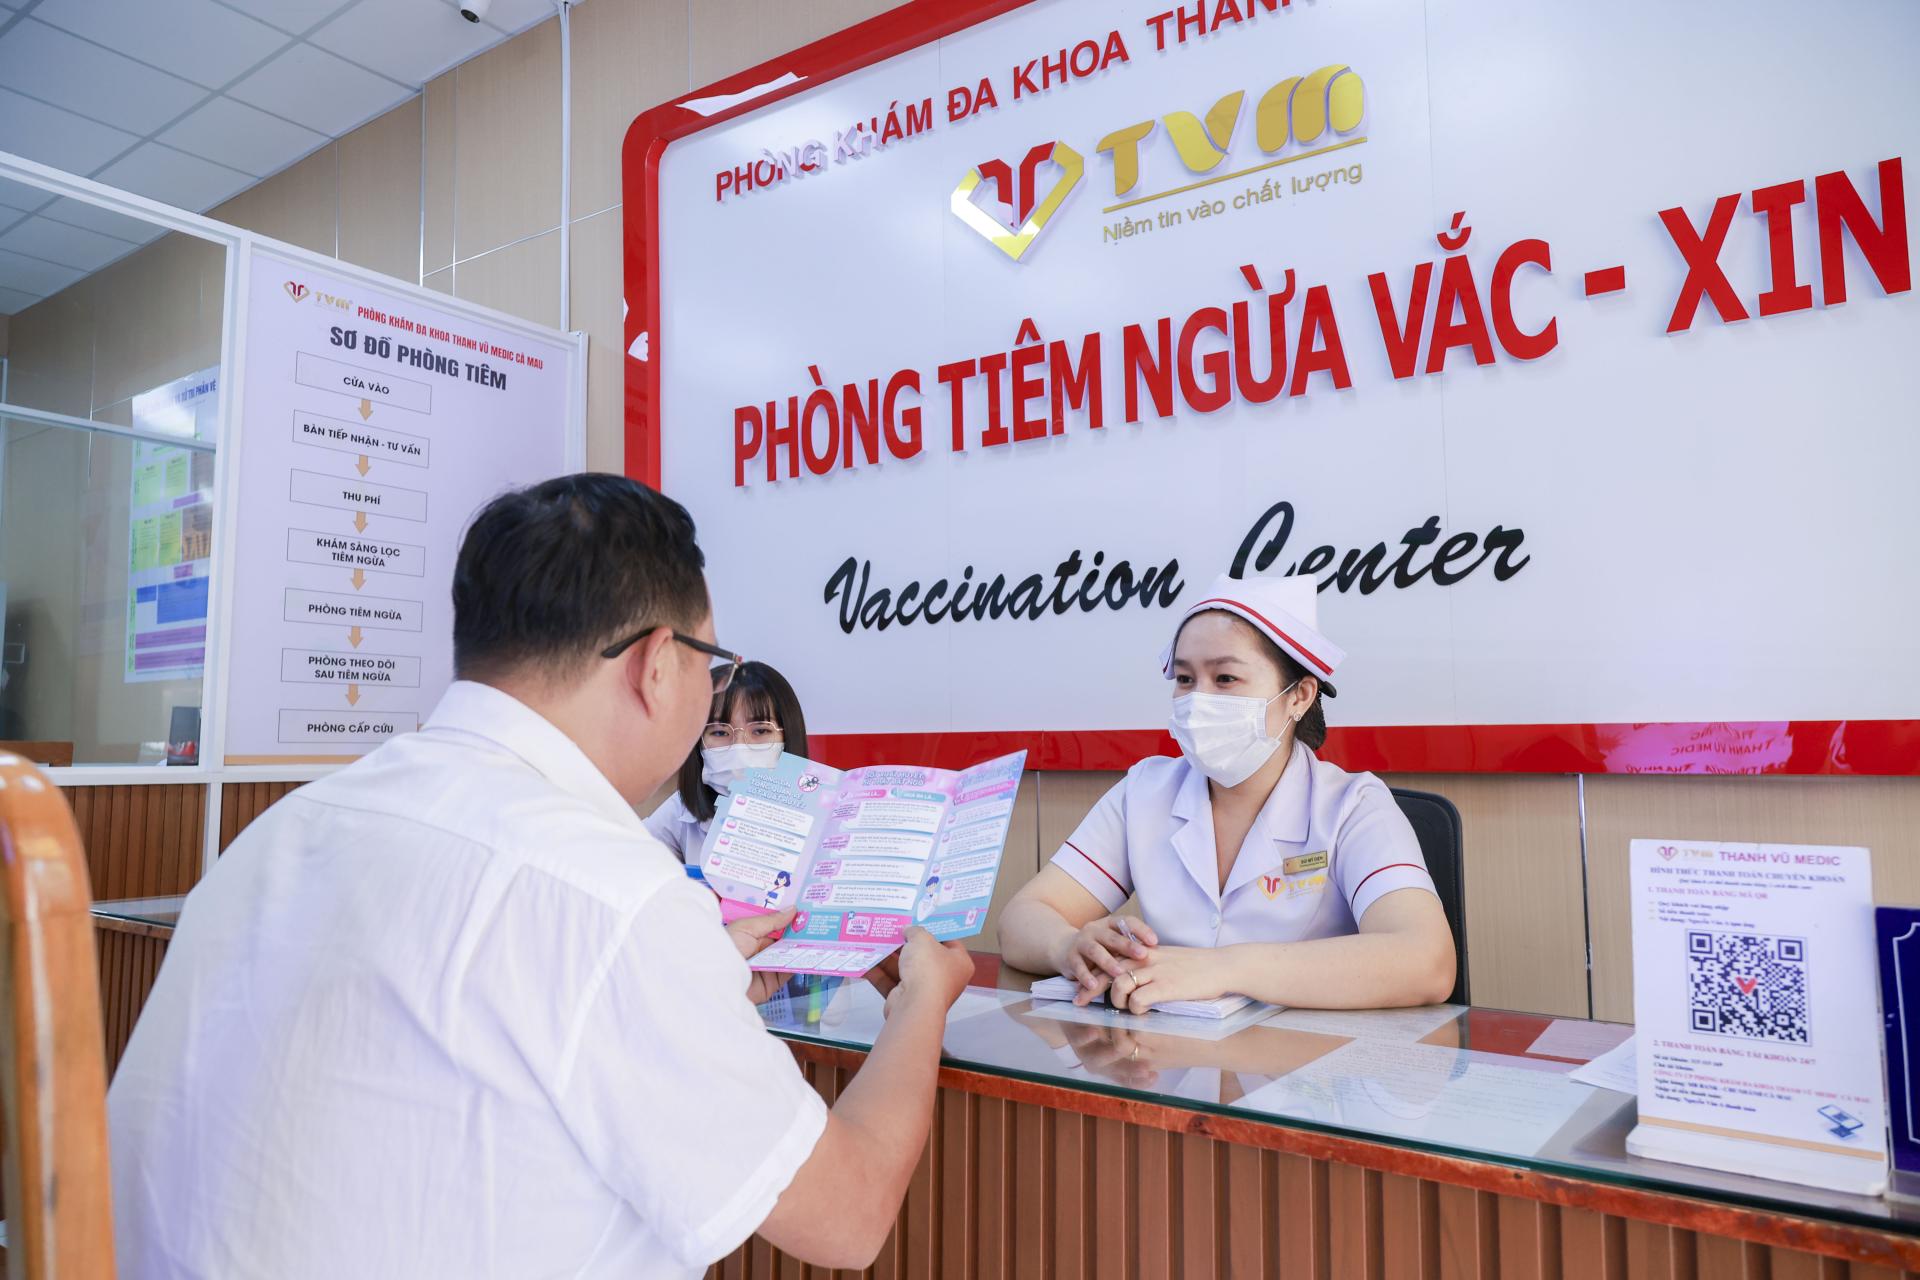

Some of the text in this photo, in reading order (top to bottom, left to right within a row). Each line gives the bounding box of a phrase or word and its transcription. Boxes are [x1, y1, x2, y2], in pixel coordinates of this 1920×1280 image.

[716, 142, 824, 202] PHÒNG
[834, 97, 933, 163] KHÁM
[947, 77, 998, 122] ĐA
[1012, 30, 1130, 100] KHOA
[1158, 210, 1182, 229] tin
[1188, 199, 1226, 221] vào
[1233, 178, 1282, 210] chất
[1291, 163, 1364, 196] lượng
[734, 364, 924, 488] PHÒNG
[938, 317, 1105, 453] TIÊM
[1122, 263, 1354, 424] NGỪA
[1367, 211, 1560, 381] VẮC
[1657, 156, 1912, 335] XIN
[358, 305, 387, 324] PHÒNG
[389, 316, 414, 332] KHÁM
[416, 323, 427, 336] ĐA
[429, 327, 450, 343] KHOA
[452, 334, 477, 350] THANH
[491, 346, 514, 362] MEDIC
[527, 356, 543, 370] MAU
[330, 326, 507, 391] SƠ ĐỒ PHÒNG TIÊM
[368, 382, 390, 395] VÀO
[303, 423, 325, 436] BÀN
[328, 428, 348, 440] TIẾP
[350, 434, 379, 448] NHẬN
[387, 441, 399, 451] TƯ
[342, 491, 382, 505] THU PHÍ
[316, 537, 347, 550] KHÁM
[380, 546, 401, 558] LỌC
[332, 551, 385, 567] TIÊM NGỪA
[824, 548, 1186, 635] Vaccination
[308, 603, 347, 615] PHÒNG
[349, 606, 371, 618] TIÊM
[308, 654, 347, 667] PHÒNG
[349, 658, 375, 668] THEO
[314, 669, 335, 679] SAU
[337, 669, 360, 680] TIÊM
[307, 721, 346, 733] PHÒNG
[1719, 851, 1767, 863] THANH
[1771, 851, 1791, 864] VŨ
[1794, 855, 1841, 866] MEDIC
